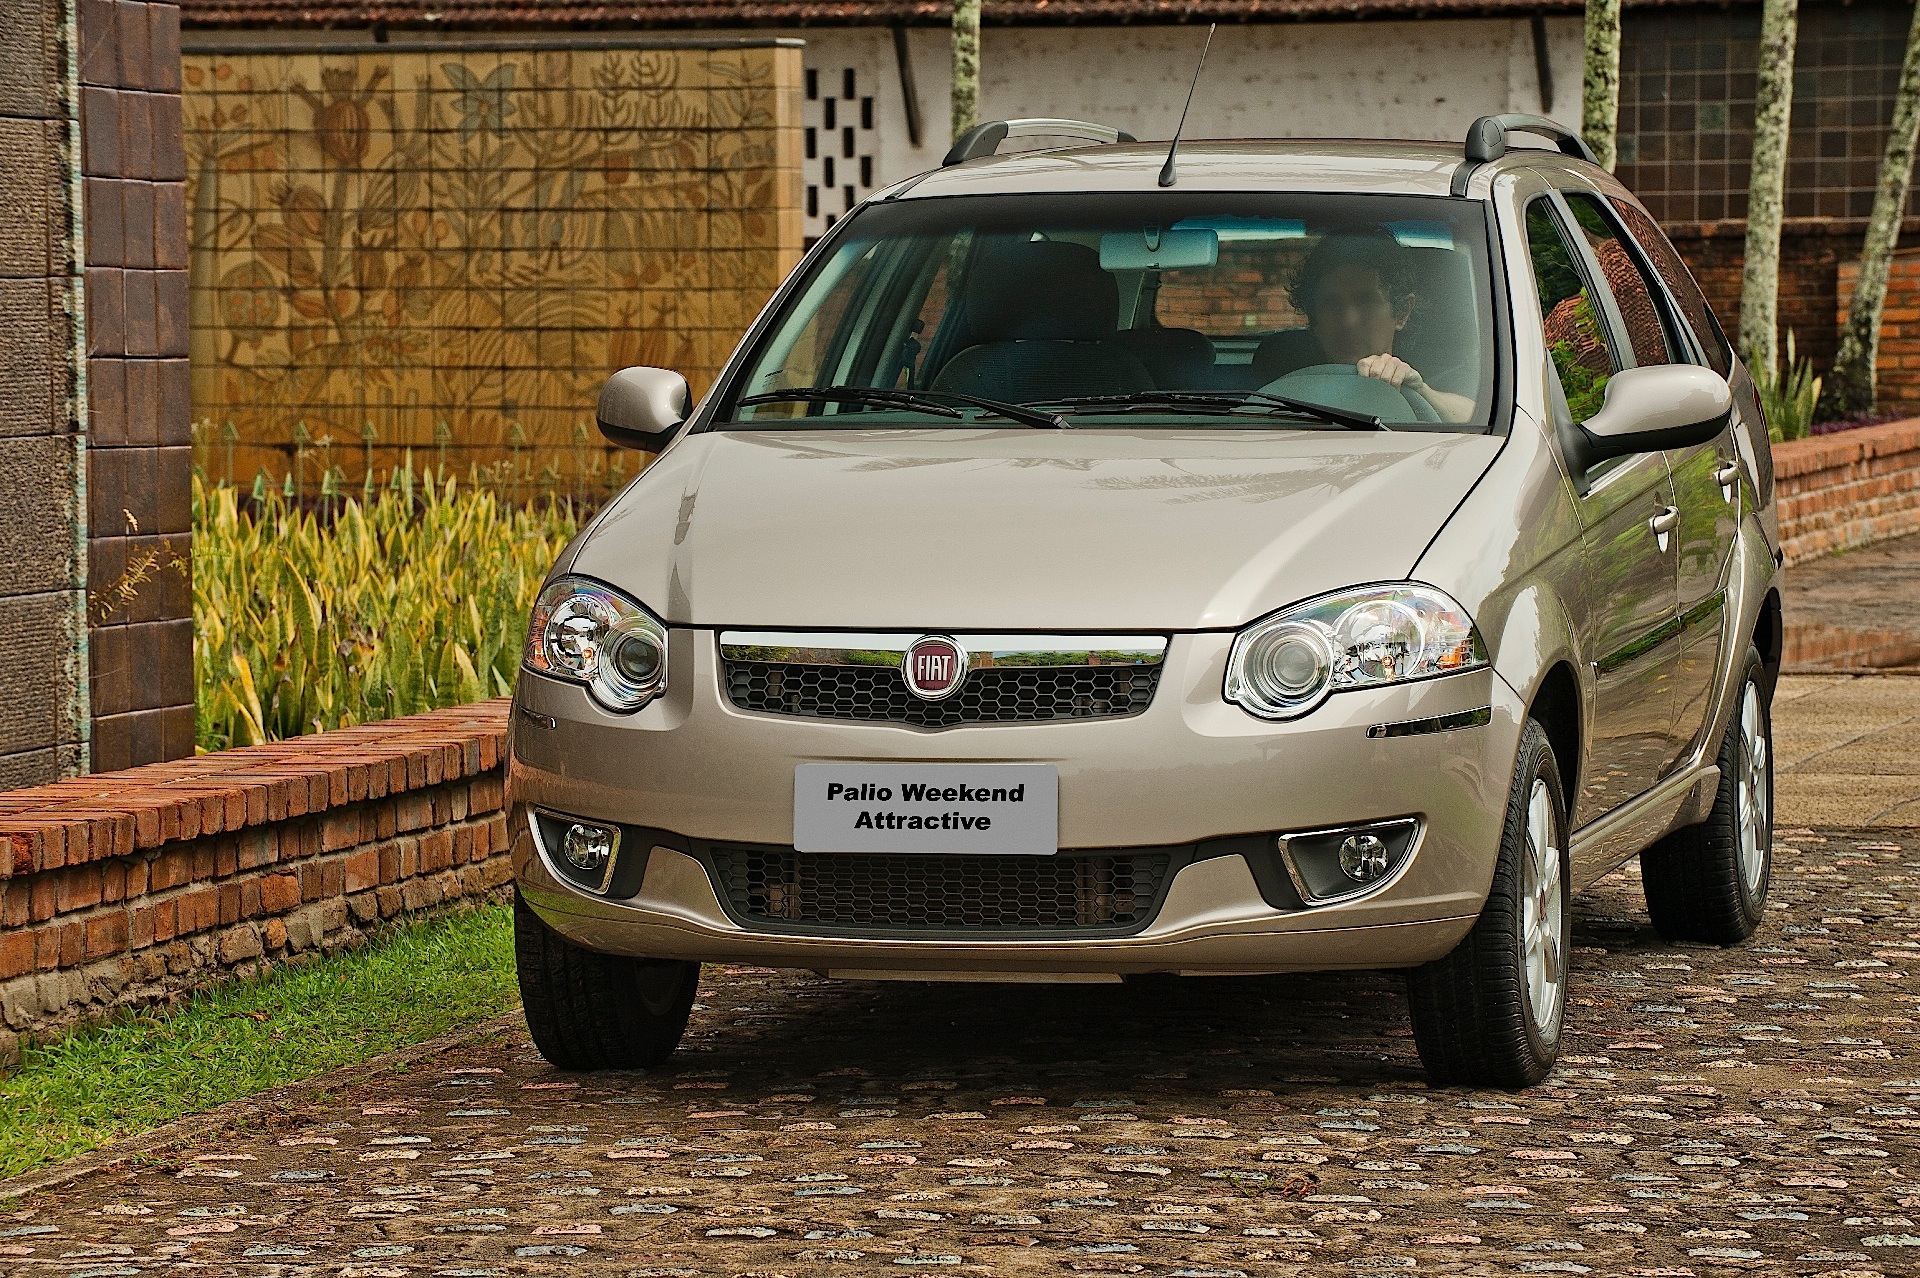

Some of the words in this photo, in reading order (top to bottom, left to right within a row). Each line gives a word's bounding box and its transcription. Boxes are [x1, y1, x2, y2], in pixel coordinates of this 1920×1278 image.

[917, 655, 952, 681] FIAT
[827, 782, 893, 802] Palio
[901, 783, 1025, 803] Weekend
[854, 811, 992, 831] Attractive
